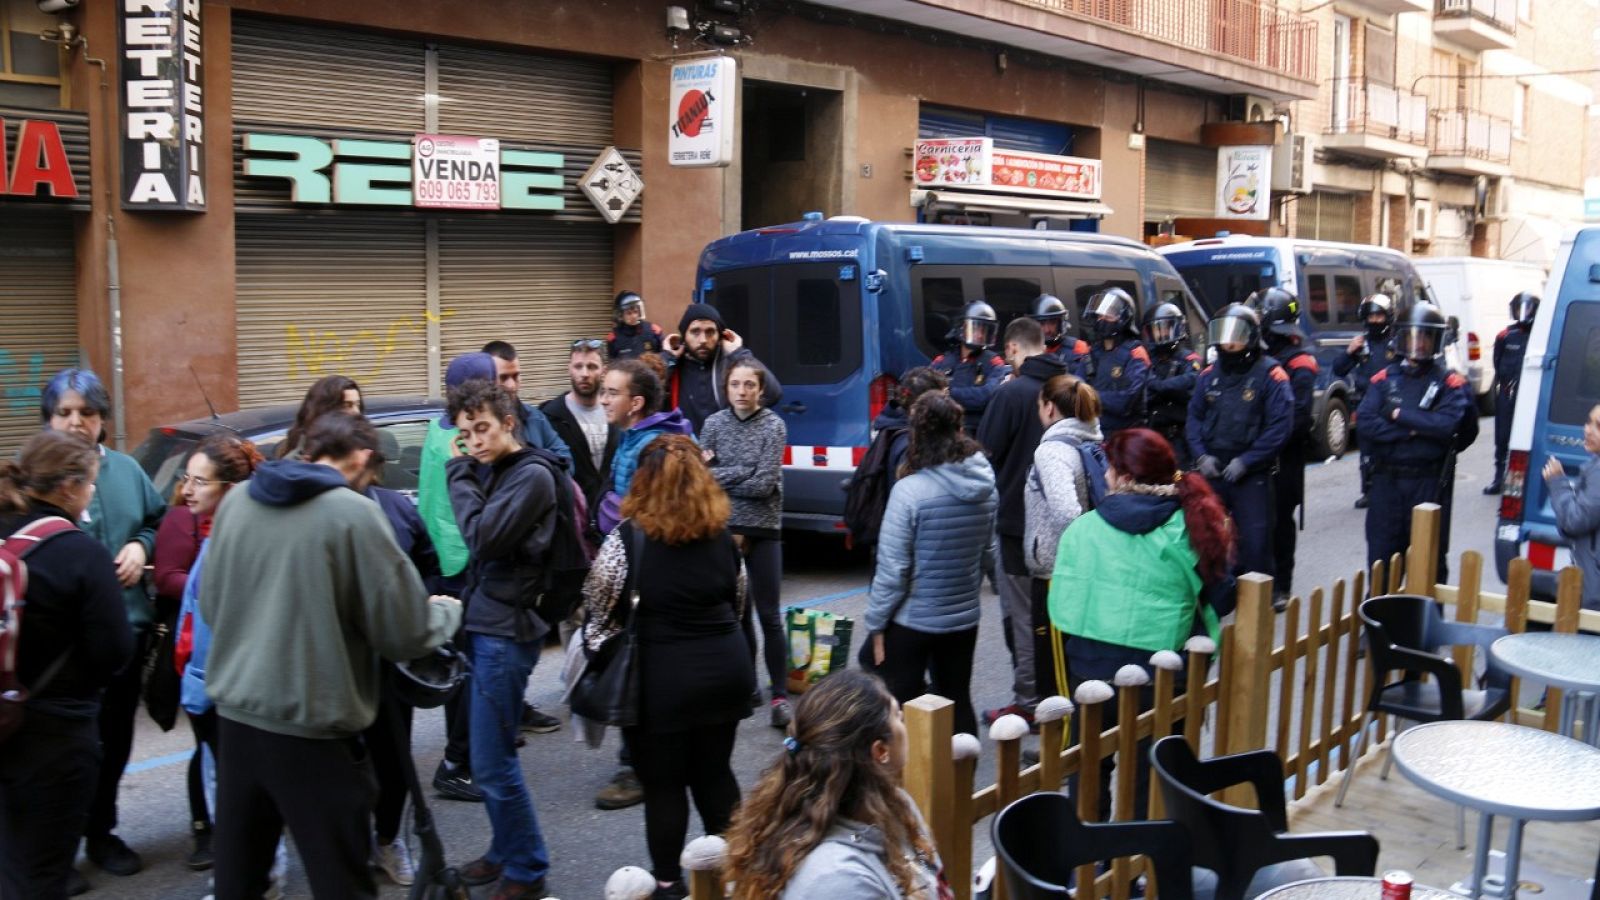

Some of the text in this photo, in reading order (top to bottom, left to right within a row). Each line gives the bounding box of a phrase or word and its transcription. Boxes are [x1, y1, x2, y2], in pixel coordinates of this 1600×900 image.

[673, 64, 717, 80] PINTURAS
[672, 88, 715, 137] TITANLUX
[0, 116, 80, 198] A
[243, 133, 565, 210] REE
[419, 159, 496, 181] VENDA
[419, 180, 497, 201] 609 065 793
[789, 248, 859, 259] www.mossos.cat
